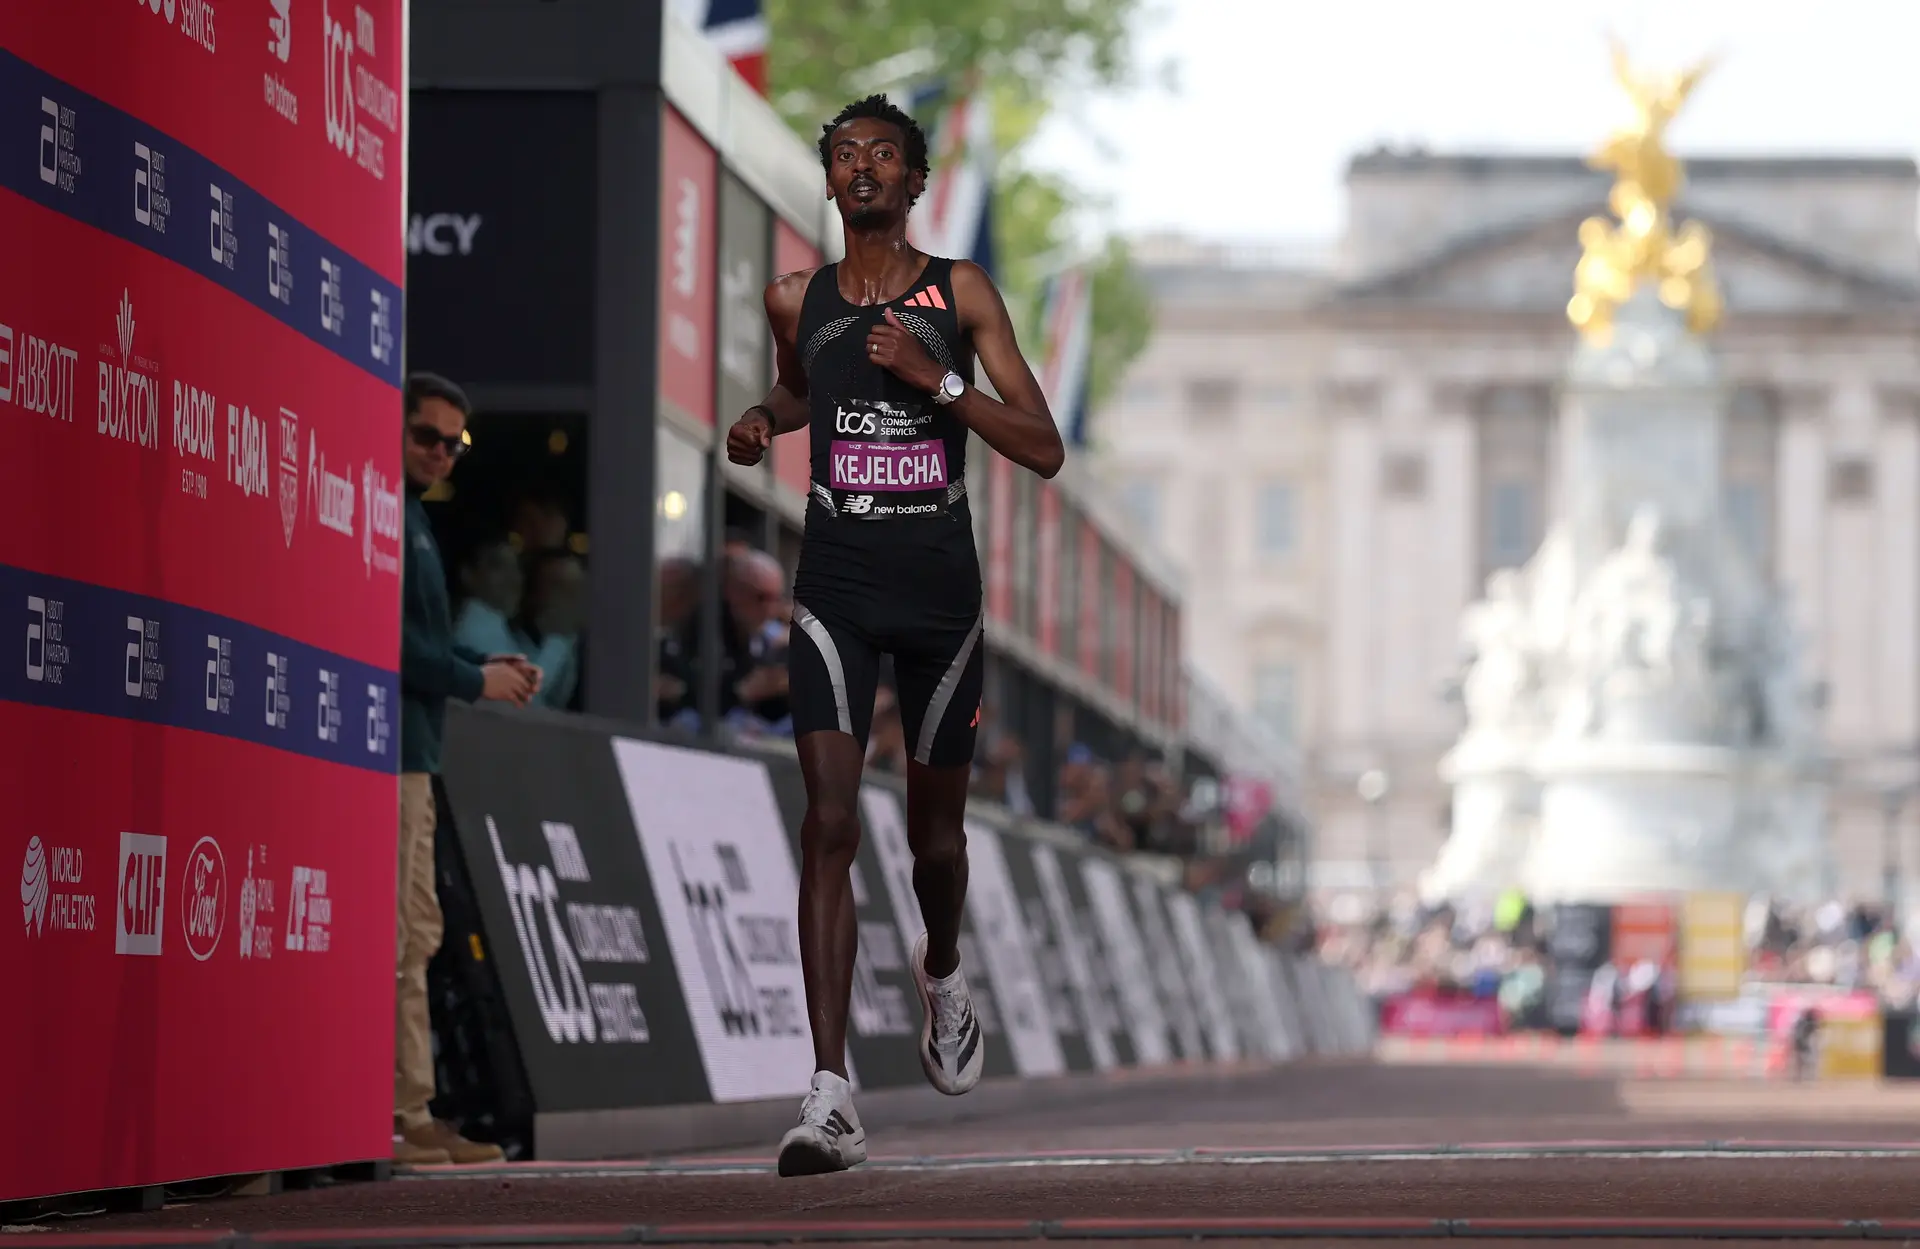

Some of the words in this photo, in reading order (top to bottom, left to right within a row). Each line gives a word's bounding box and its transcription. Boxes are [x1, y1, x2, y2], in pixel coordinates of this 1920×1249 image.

[59, 104, 76, 130] ABBOTT
[59, 127, 75, 151] WORLD
[58, 148, 82, 175] MARATHON
[57, 169, 75, 194] MAJORS
[15, 332, 78, 423] ABBOTT
[98, 361, 159, 451] BUXTON
[174, 380, 216, 462] RADOX
[835, 406, 876, 435] tcs
[881, 427, 917, 436] SERVICES
[227, 404, 269, 498] FLORA
[834, 454, 943, 486] KEJELCHA
[874, 505, 895, 514] new
[897, 504, 938, 514] balance
[46, 600, 64, 620] ABBOTT
[46, 621, 62, 642] WORLD
[144, 619, 160, 641] ABBOTT
[45, 643, 70, 665] MARATHON
[144, 640, 159, 660] WORLD
[44, 665, 63, 685] MAJORS
[143, 660, 165, 681] MARATHON
[142, 680, 158, 700] MAJORS
[51, 847, 82, 883] WORLD
[122, 852, 163, 935] CLIF
[190, 853, 220, 938] Ford
[51, 893, 95, 931] ATHLETICS
